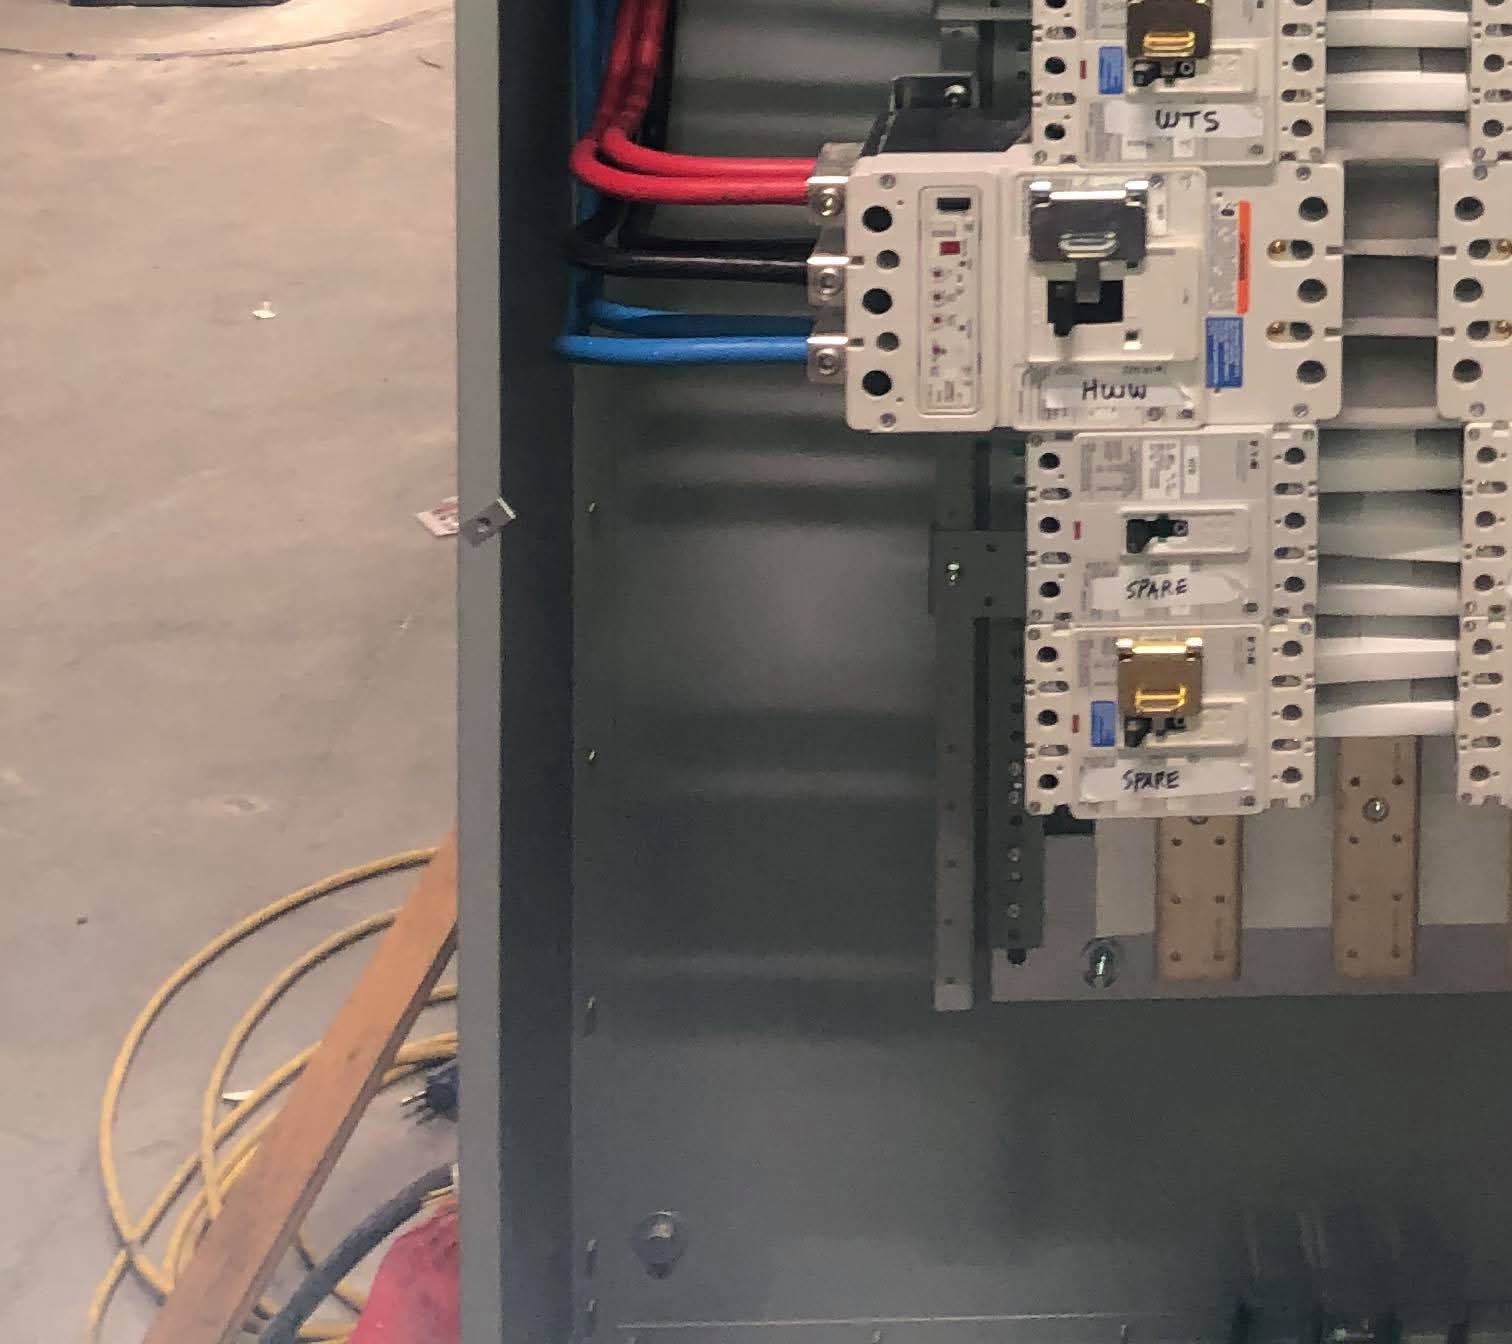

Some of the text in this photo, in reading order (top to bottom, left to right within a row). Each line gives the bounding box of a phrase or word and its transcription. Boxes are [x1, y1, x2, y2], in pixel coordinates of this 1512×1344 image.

[1155, 110, 1220, 132] WTS
[1126, 578, 1189, 600] SPARE
[1121, 768, 1182, 793] SPARE
